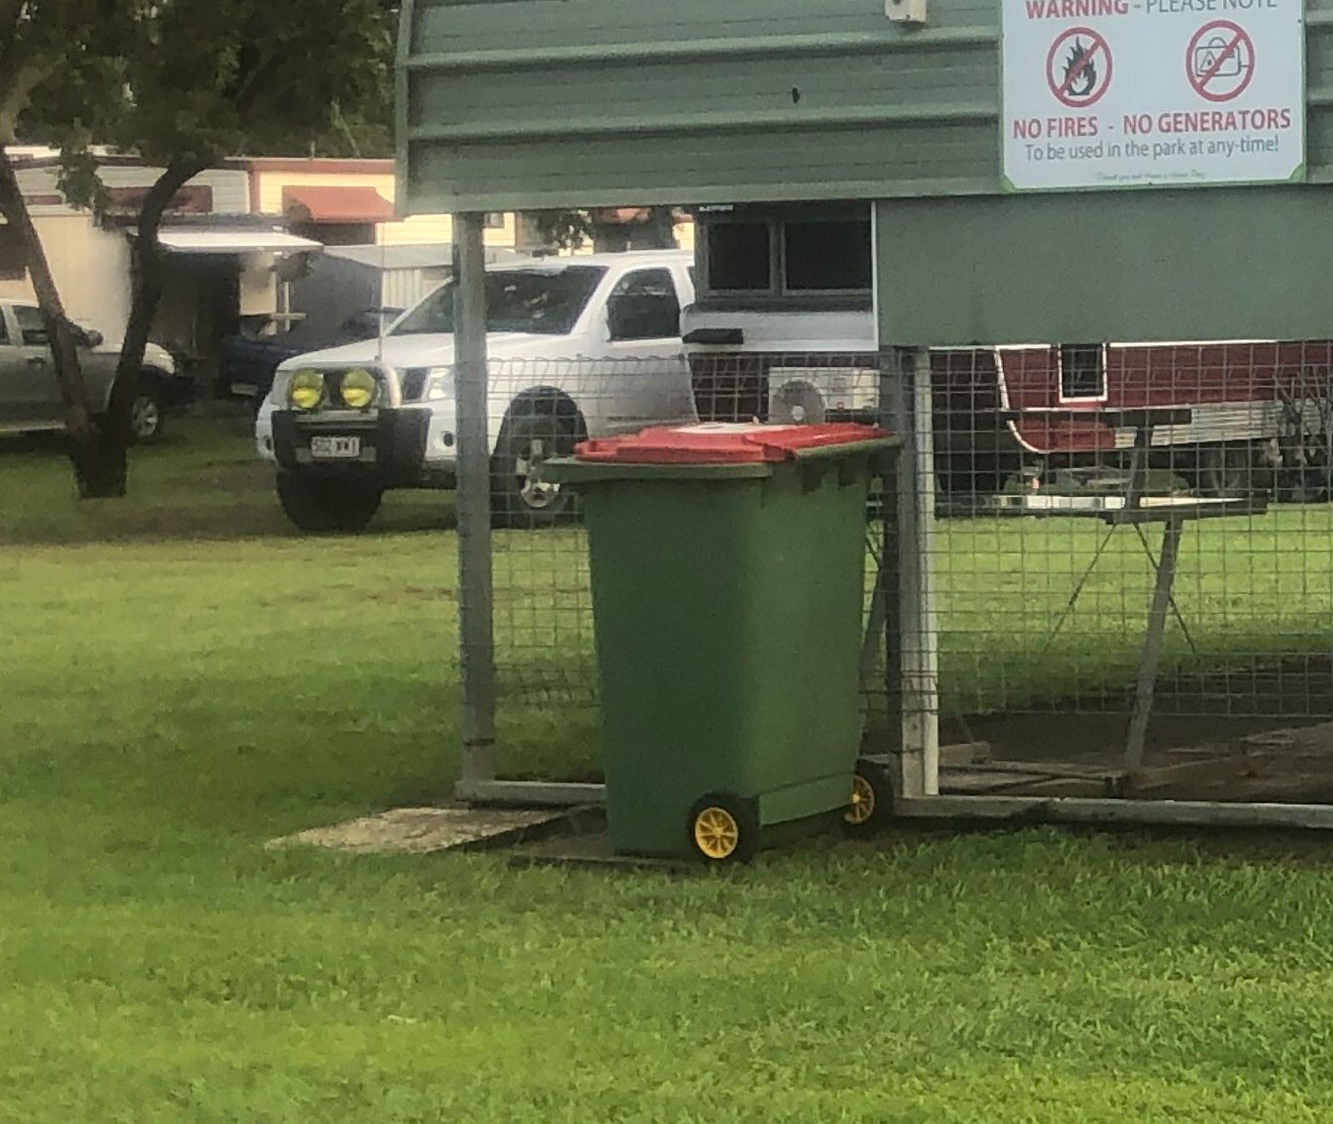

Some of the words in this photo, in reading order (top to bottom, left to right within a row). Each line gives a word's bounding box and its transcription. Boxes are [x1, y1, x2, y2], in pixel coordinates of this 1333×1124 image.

[1013, 118, 1042, 139] NO
[1047, 116, 1098, 137] FIRES
[1123, 114, 1153, 135] NO
[1158, 108, 1291, 133] GENERATORS
[1025, 144, 1044, 161] To
[1047, 143, 1066, 160] be
[1068, 140, 1103, 159] used
[1107, 141, 1121, 157] in
[1125, 140, 1149, 157] the
[1153, 138, 1186, 160] park
[1189, 140, 1204, 155] at
[1207, 134, 1279, 158] any-time!
